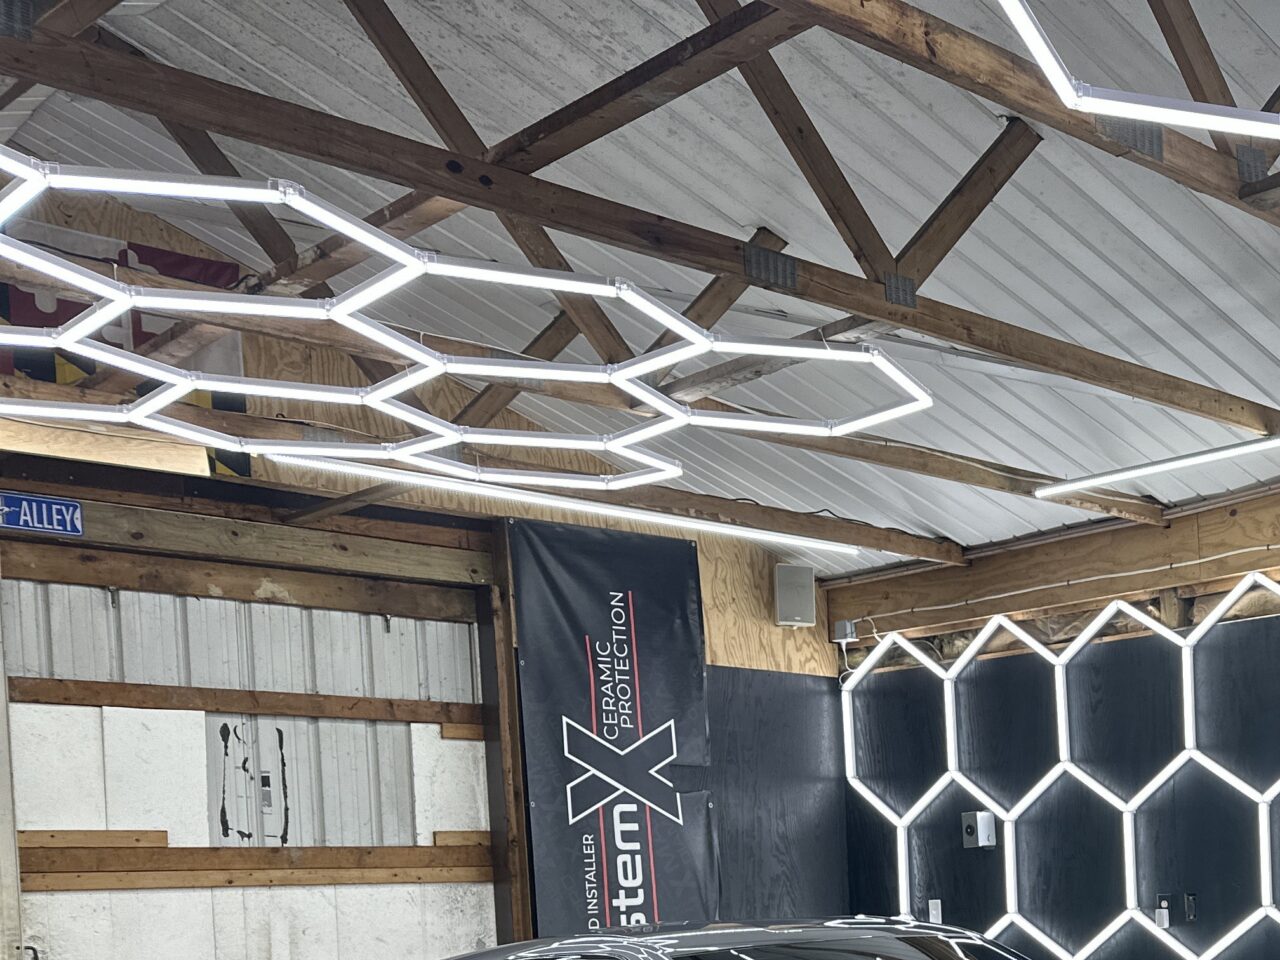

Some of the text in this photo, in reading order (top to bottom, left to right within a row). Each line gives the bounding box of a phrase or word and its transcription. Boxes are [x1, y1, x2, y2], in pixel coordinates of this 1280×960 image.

[20, 501, 73, 531] ALLEY
[596, 641, 619, 740] CERAMIC
[610, 591, 634, 729] PROTECTION
[582, 834, 600, 914] INSTALLER
